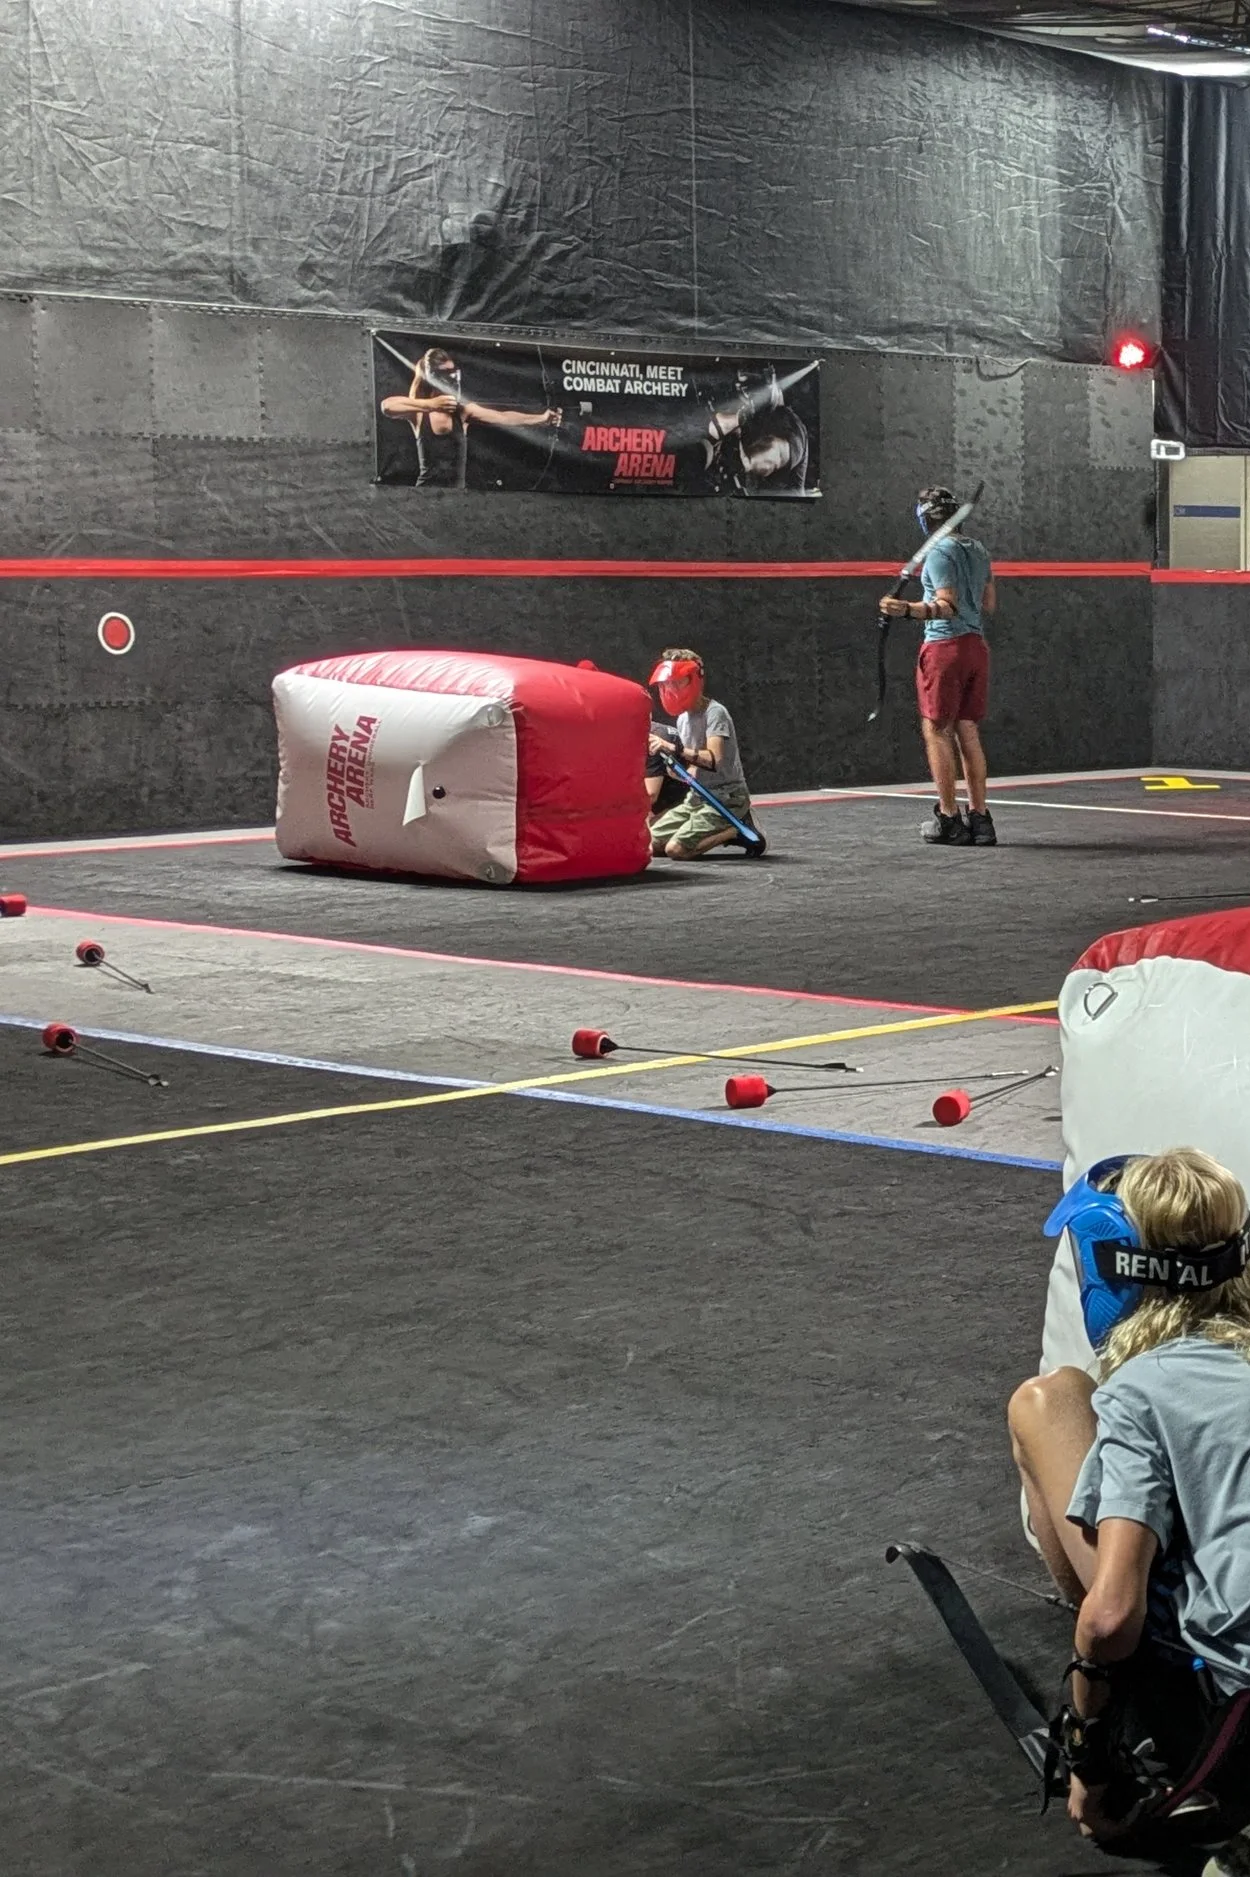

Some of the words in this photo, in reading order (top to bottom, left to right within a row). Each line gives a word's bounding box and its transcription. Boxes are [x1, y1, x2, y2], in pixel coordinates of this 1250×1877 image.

[562, 360, 643, 379] CINCINNATI,
[646, 366, 683, 380] MEET
[563, 377, 621, 393] COMBAT
[624, 382, 688, 397] ARCHERY
[583, 427, 666, 453] ARCHERY
[615, 453, 675, 477] ARENA
[345, 715, 378, 808] ARENA
[326, 723, 357, 848] ARCHERY
[1115, 1250, 1214, 1287] RENAL
